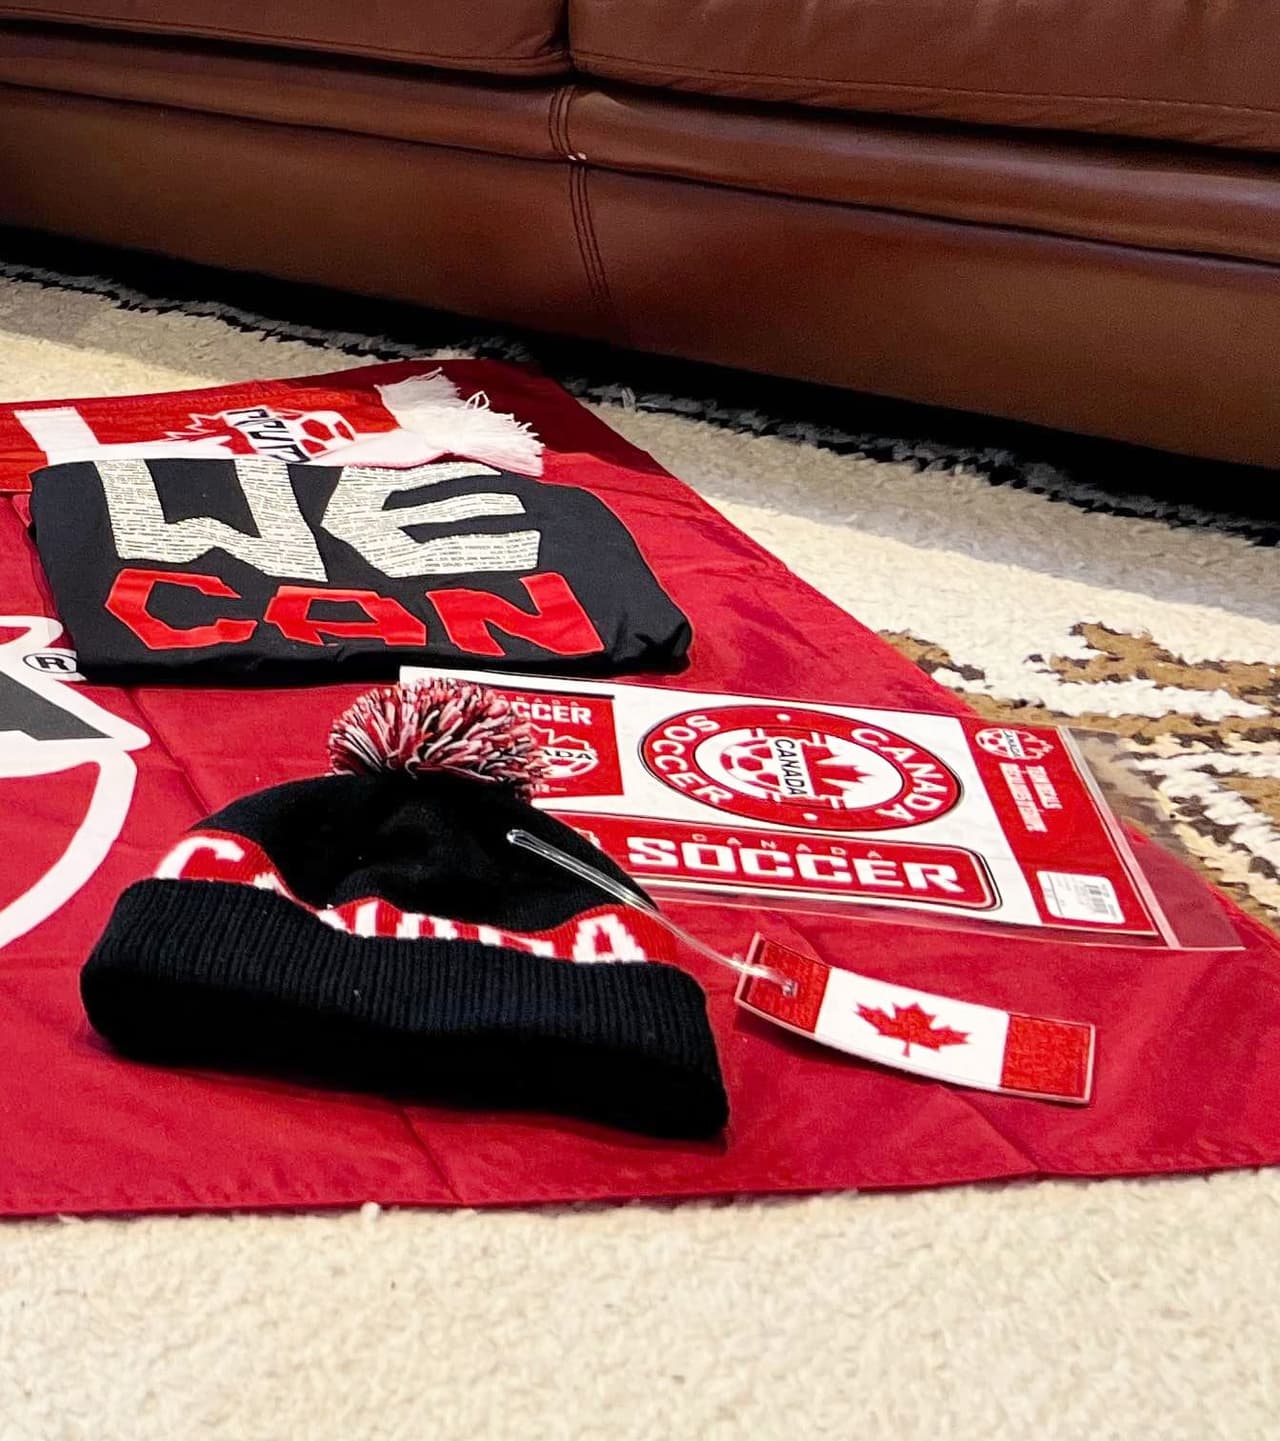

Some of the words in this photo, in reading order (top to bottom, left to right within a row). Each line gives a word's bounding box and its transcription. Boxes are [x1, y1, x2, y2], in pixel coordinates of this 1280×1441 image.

[93, 458, 541, 582] WE
[104, 569, 605, 656] CAN
[510, 700, 593, 726] CCER
[651, 714, 735, 804] SOCCER
[774, 738, 808, 797] CANADA
[850, 727, 949, 822] CANADA
[626, 836, 967, 894] SOCCER
[692, 833, 883, 860] CANADA
